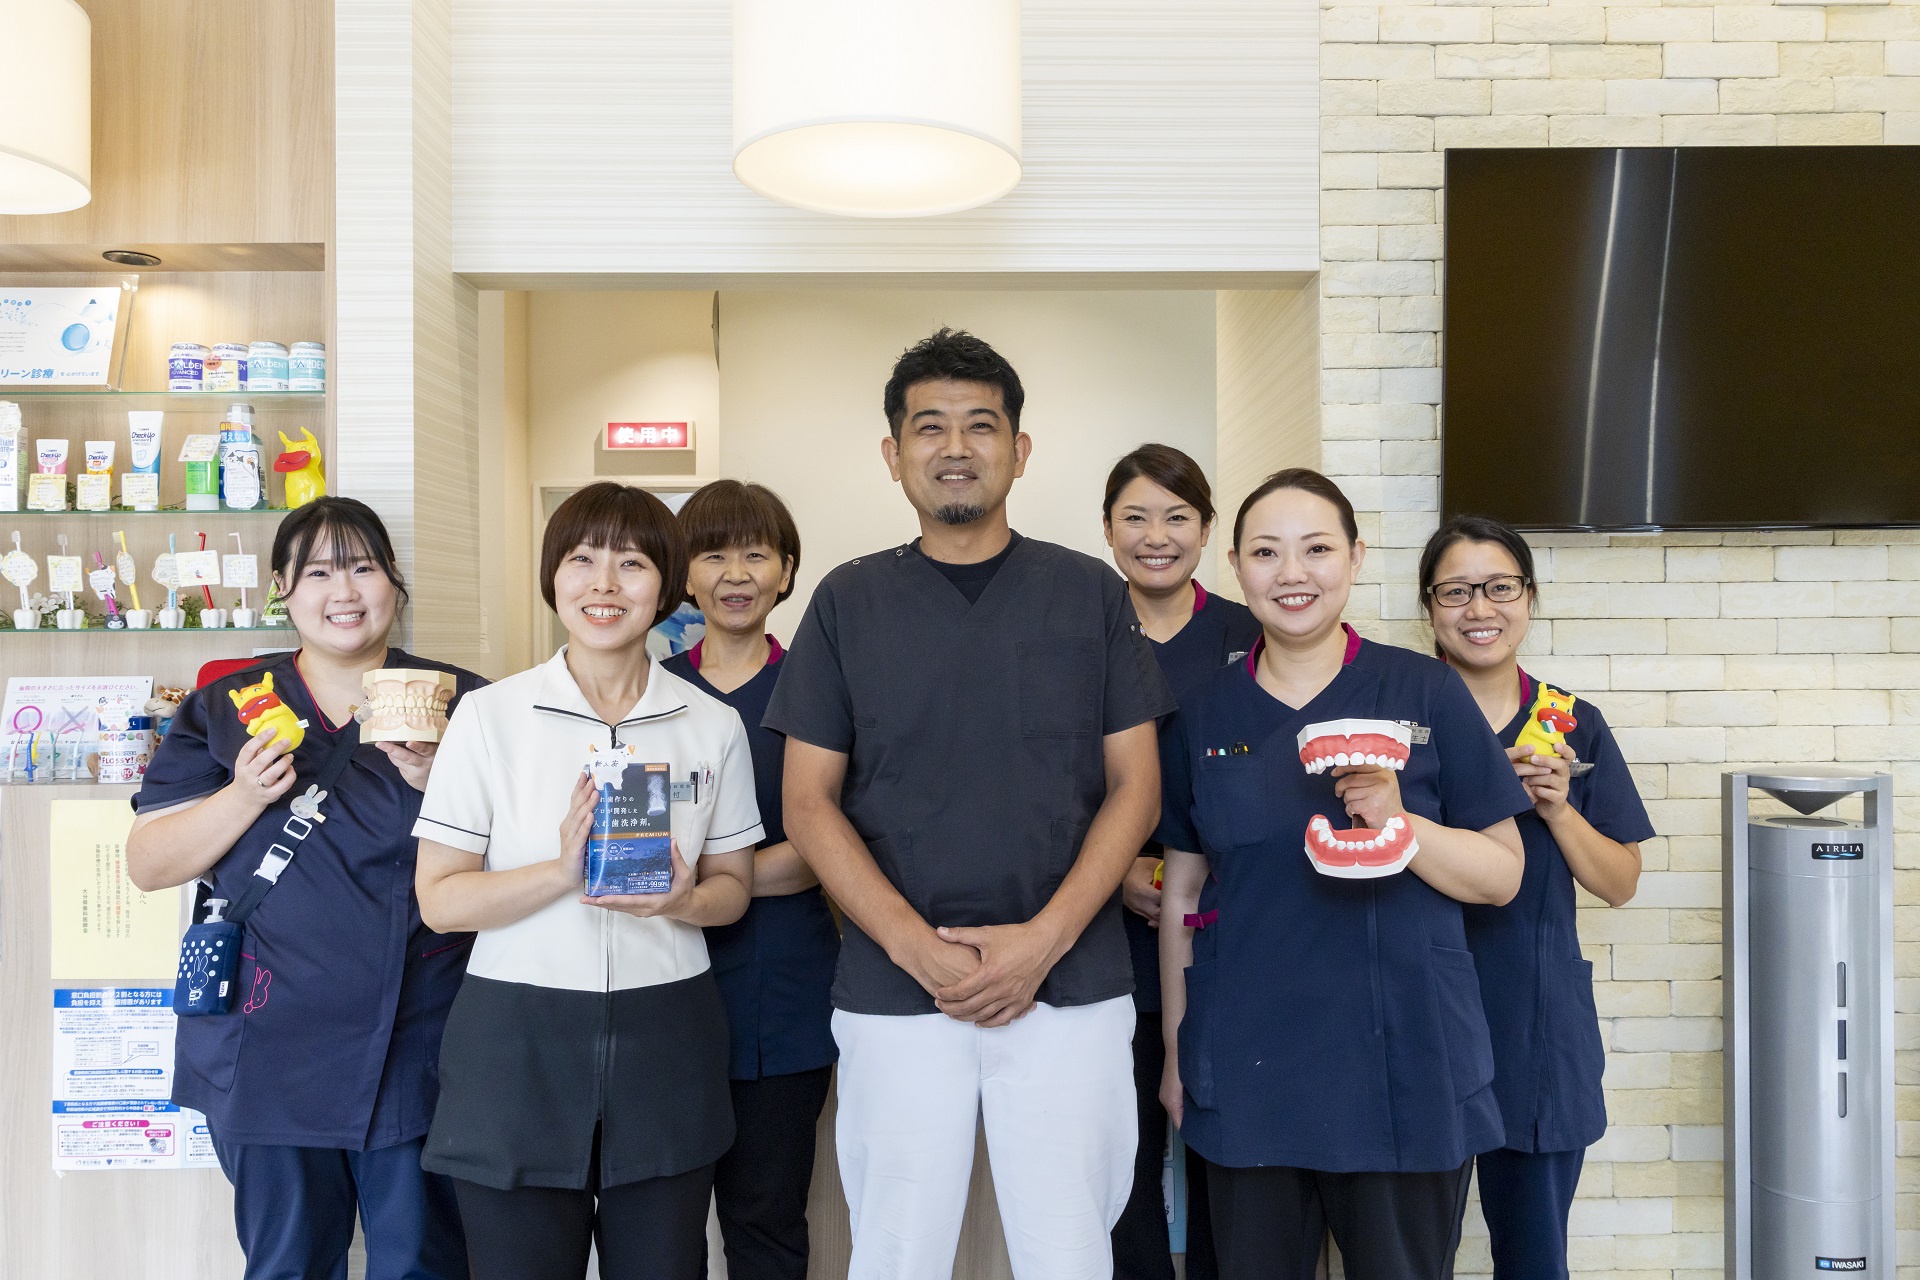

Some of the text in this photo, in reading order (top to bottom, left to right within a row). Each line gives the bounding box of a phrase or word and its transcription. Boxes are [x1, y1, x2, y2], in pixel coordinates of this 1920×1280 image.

[617, 426, 678, 444] 使用中
[1831, 1260, 1864, 1269] IWASAKI
